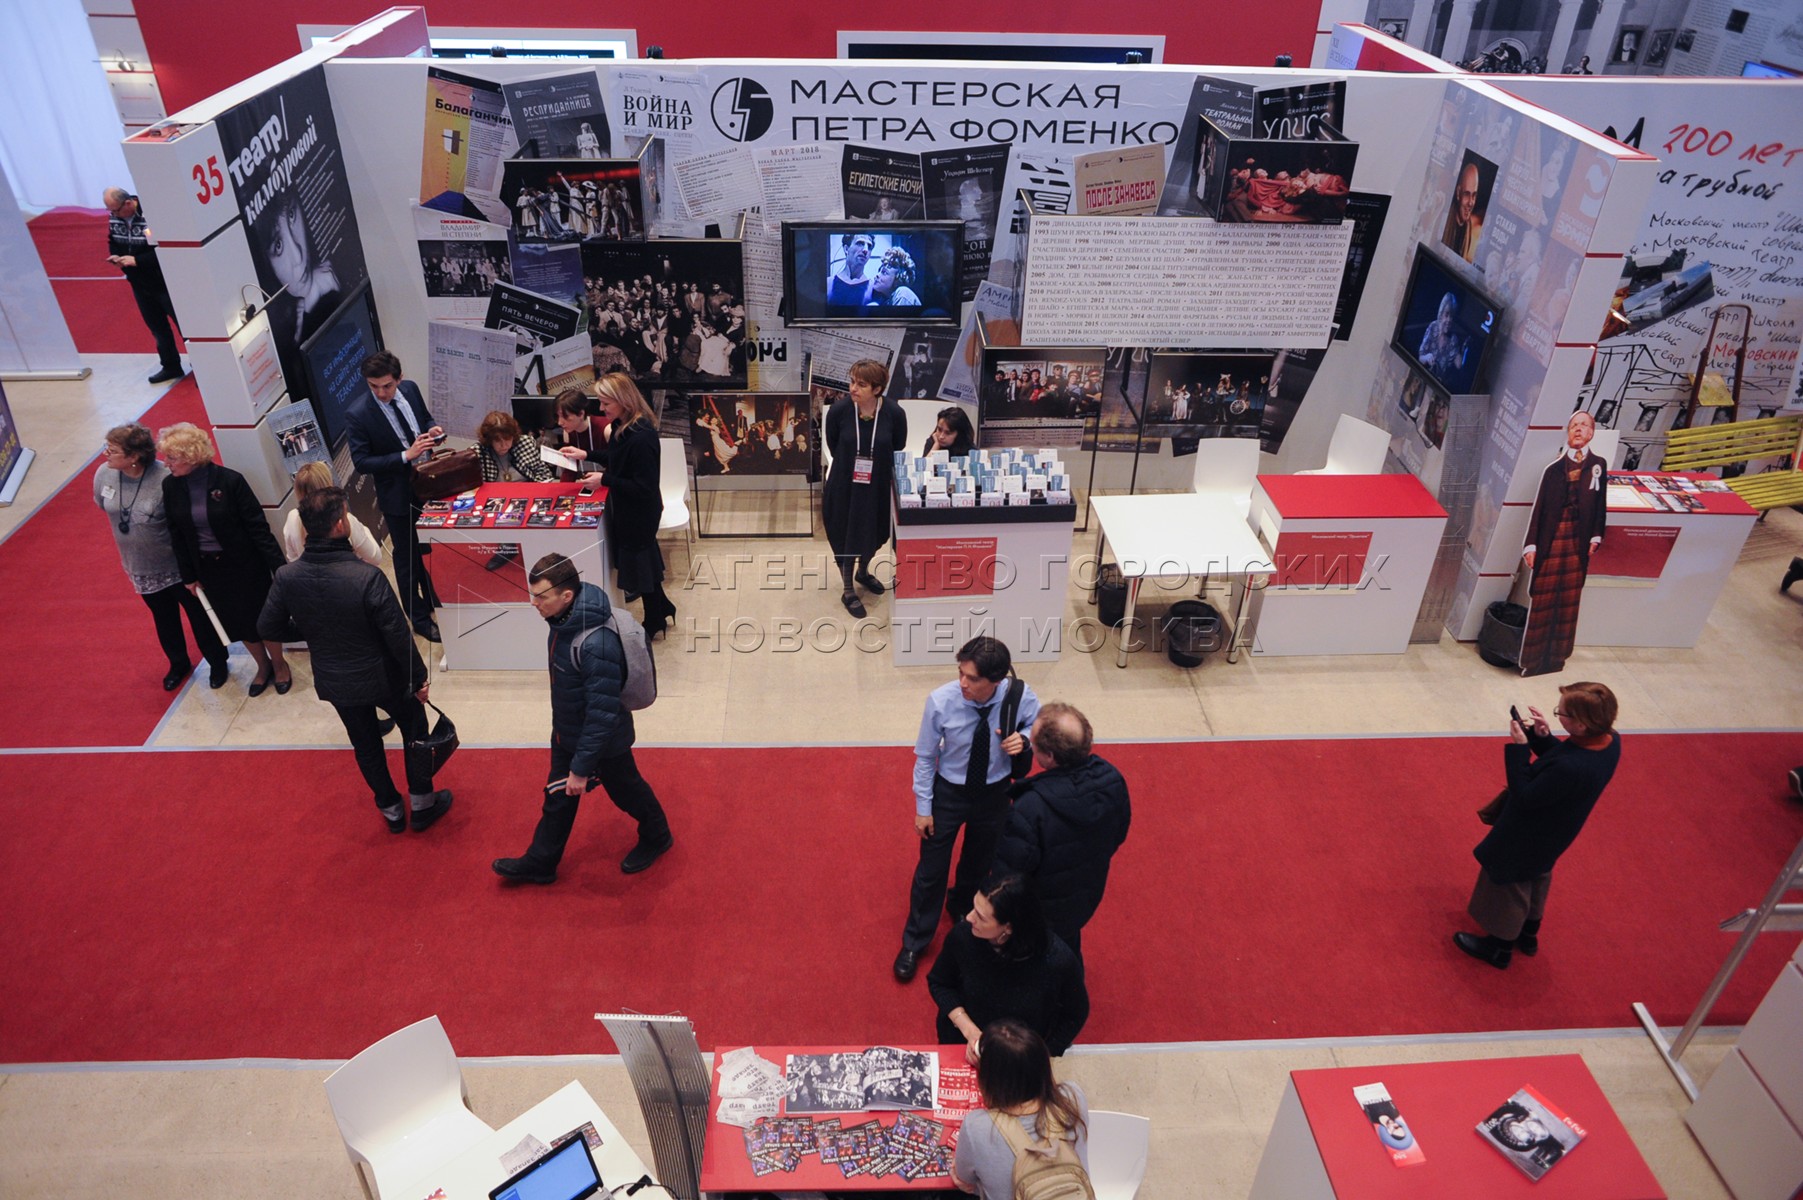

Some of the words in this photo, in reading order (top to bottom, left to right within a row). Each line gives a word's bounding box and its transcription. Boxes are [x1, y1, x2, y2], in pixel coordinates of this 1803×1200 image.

[623, 94, 693, 116] ВОЙНА
[791, 79, 1120, 109] МАСТЕРСКАЯ
[623, 110, 637, 126] И
[647, 112, 693, 130] МИР
[792, 116, 936, 141] ПЕТРА
[949, 118, 1179, 145] ФОМЕНКО
[770, 148, 796, 156] МАРТ
[1663, 123, 1734, 156] 200
[192, 156, 225, 205] 35
[849, 171, 899, 191] ЕГИПЕТСКИЕ
[899, 178, 922, 194] НОЧИ
[1086, 186, 1113, 208] ПОСЛЕ
[1115, 180, 1156, 205] ЗАНАВЕСА
[501, 305, 522, 318] ПЯТЬ
[524, 311, 560, 330] ВЕЧЕРОВ
